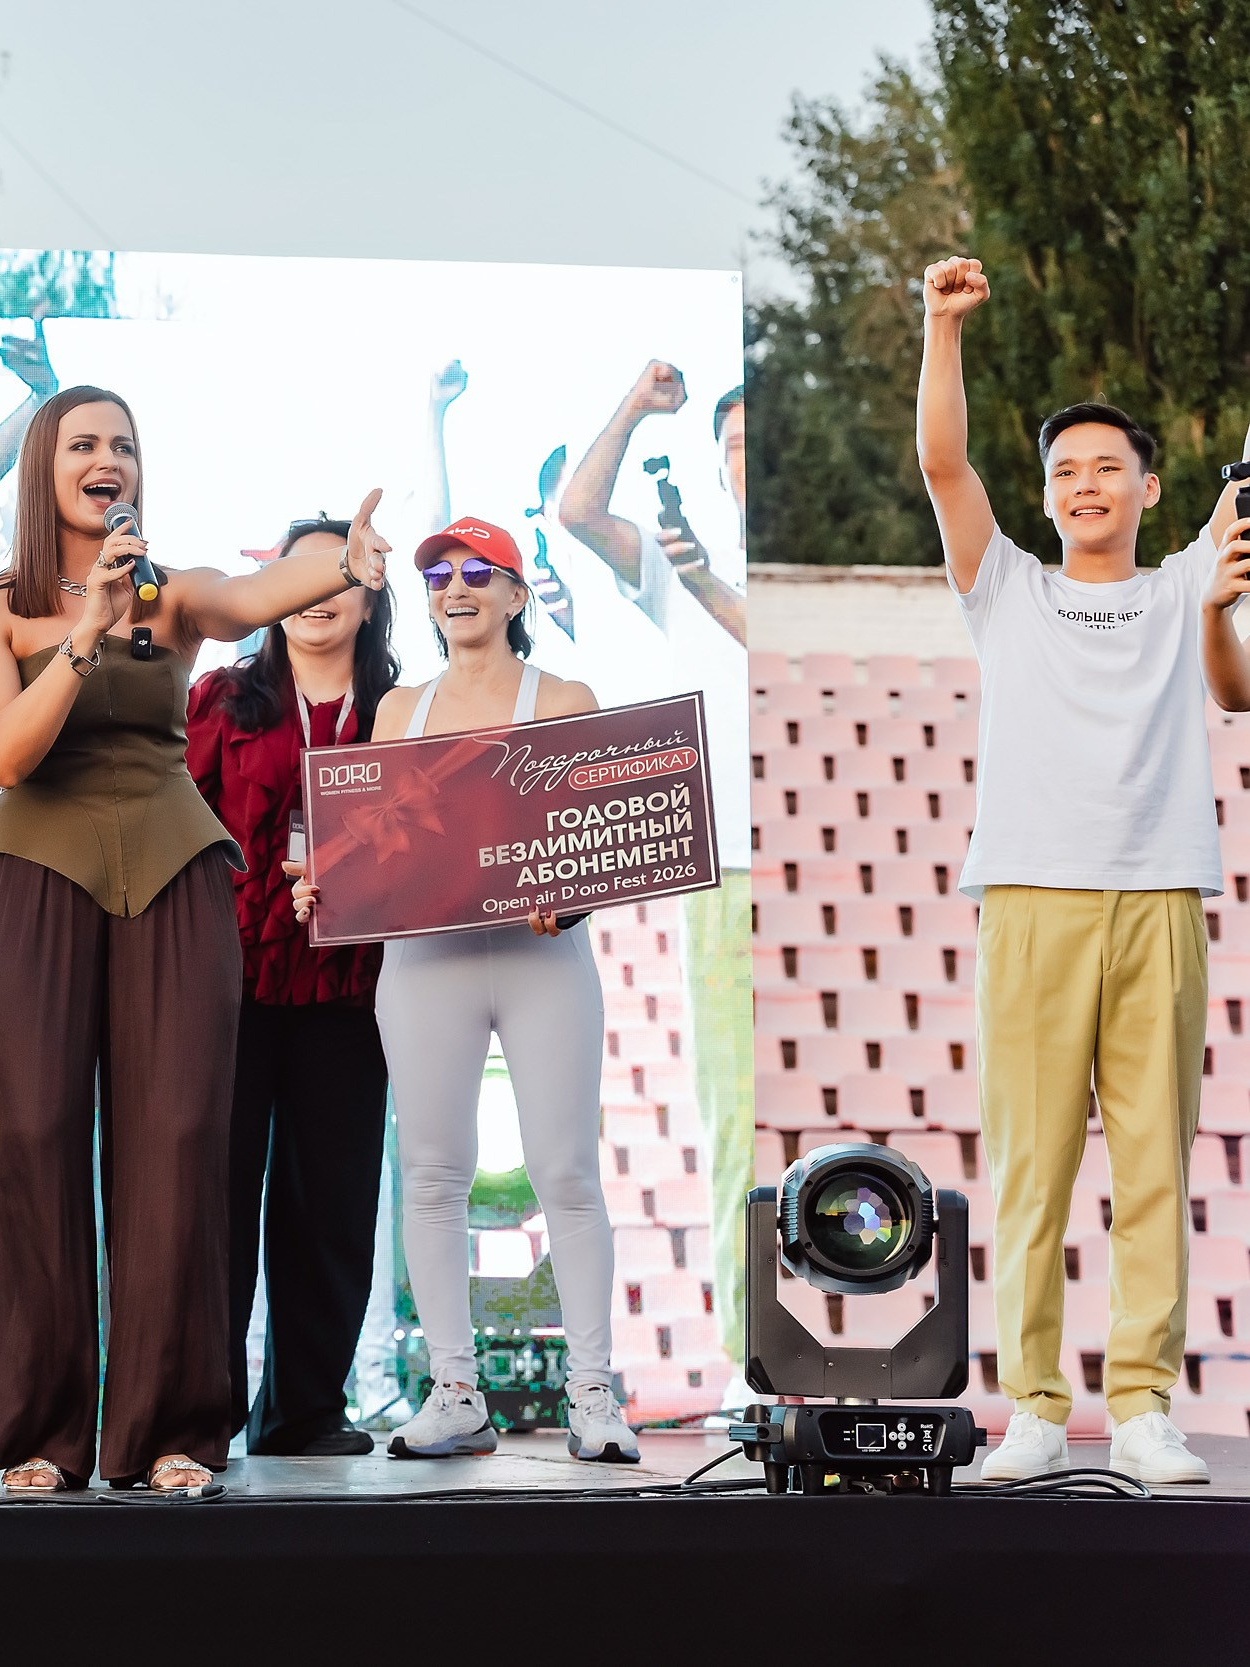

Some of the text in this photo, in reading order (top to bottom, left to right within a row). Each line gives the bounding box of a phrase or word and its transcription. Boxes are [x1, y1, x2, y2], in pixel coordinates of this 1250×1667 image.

[318, 762, 382, 788] D'ORO
[472, 731, 689, 796] Подарочный
[573, 751, 691, 786] СЕРТИФИКАТ
[546, 782, 691, 832] ГОДОВОЙ
[478, 807, 693, 868] БЕЗЛИМИТНЫЙ
[516, 836, 694, 888] АБОНЕМЕНТ
[482, 895, 530, 914] Open
[535, 890, 557, 905] air
[613, 874, 647, 890] Fest
[652, 862, 697, 884] 2026
